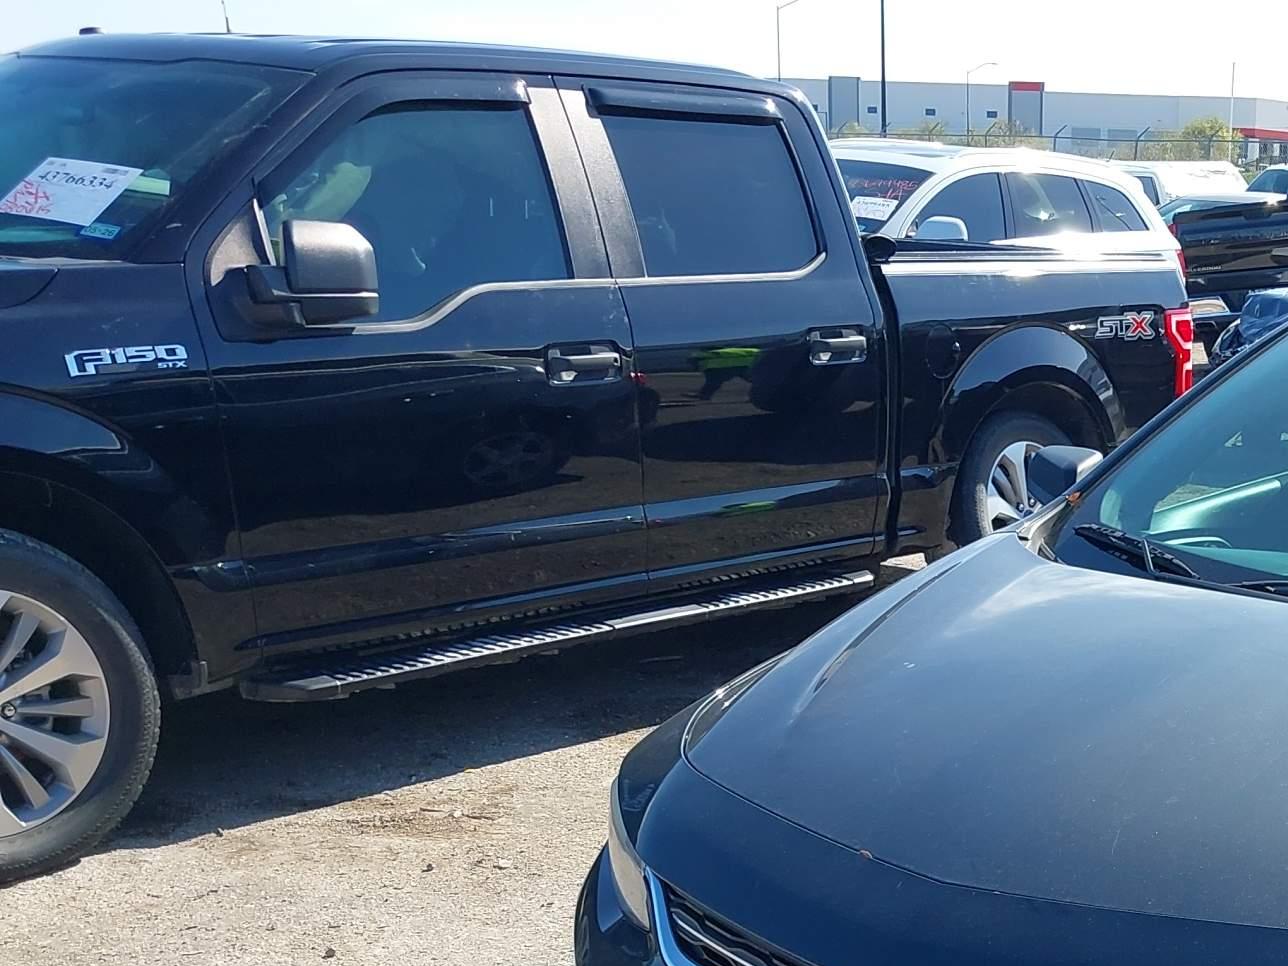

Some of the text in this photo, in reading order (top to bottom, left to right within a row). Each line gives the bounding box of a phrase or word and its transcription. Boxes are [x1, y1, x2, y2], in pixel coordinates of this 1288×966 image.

[38, 171, 118, 190] 43766334
[1095, 311, 1155, 341] STX
[157, 360, 188, 369] STX
